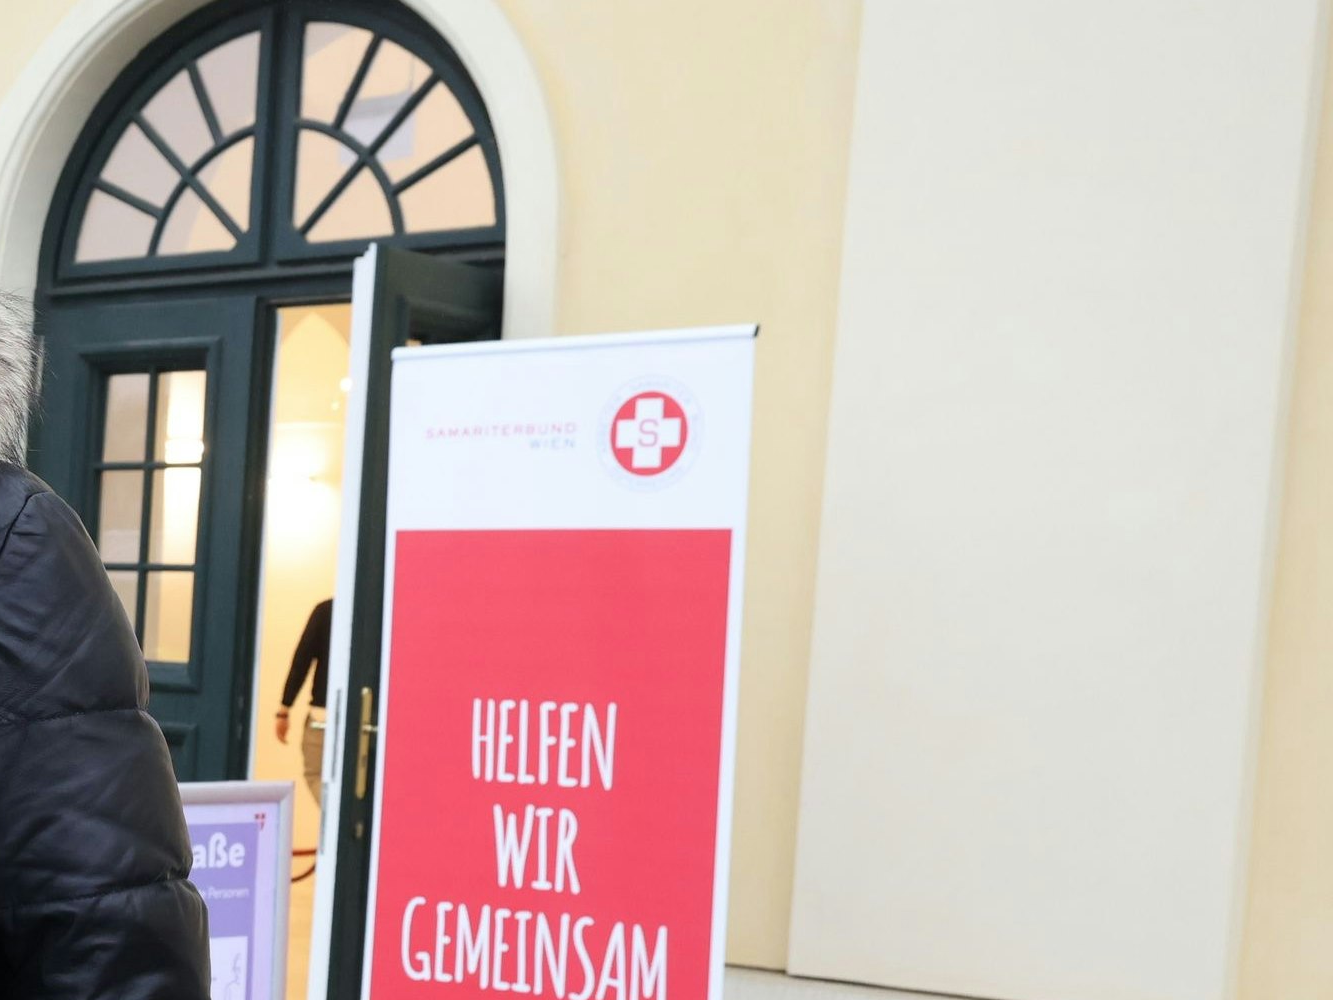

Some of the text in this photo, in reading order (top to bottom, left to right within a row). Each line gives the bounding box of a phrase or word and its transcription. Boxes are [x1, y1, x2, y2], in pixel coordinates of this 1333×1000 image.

[425, 421, 577, 439] SAMARITERBUND
[529, 438, 576, 451] WIEN
[471, 697, 617, 791] HELFEN
[493, 803, 581, 895] WIR
